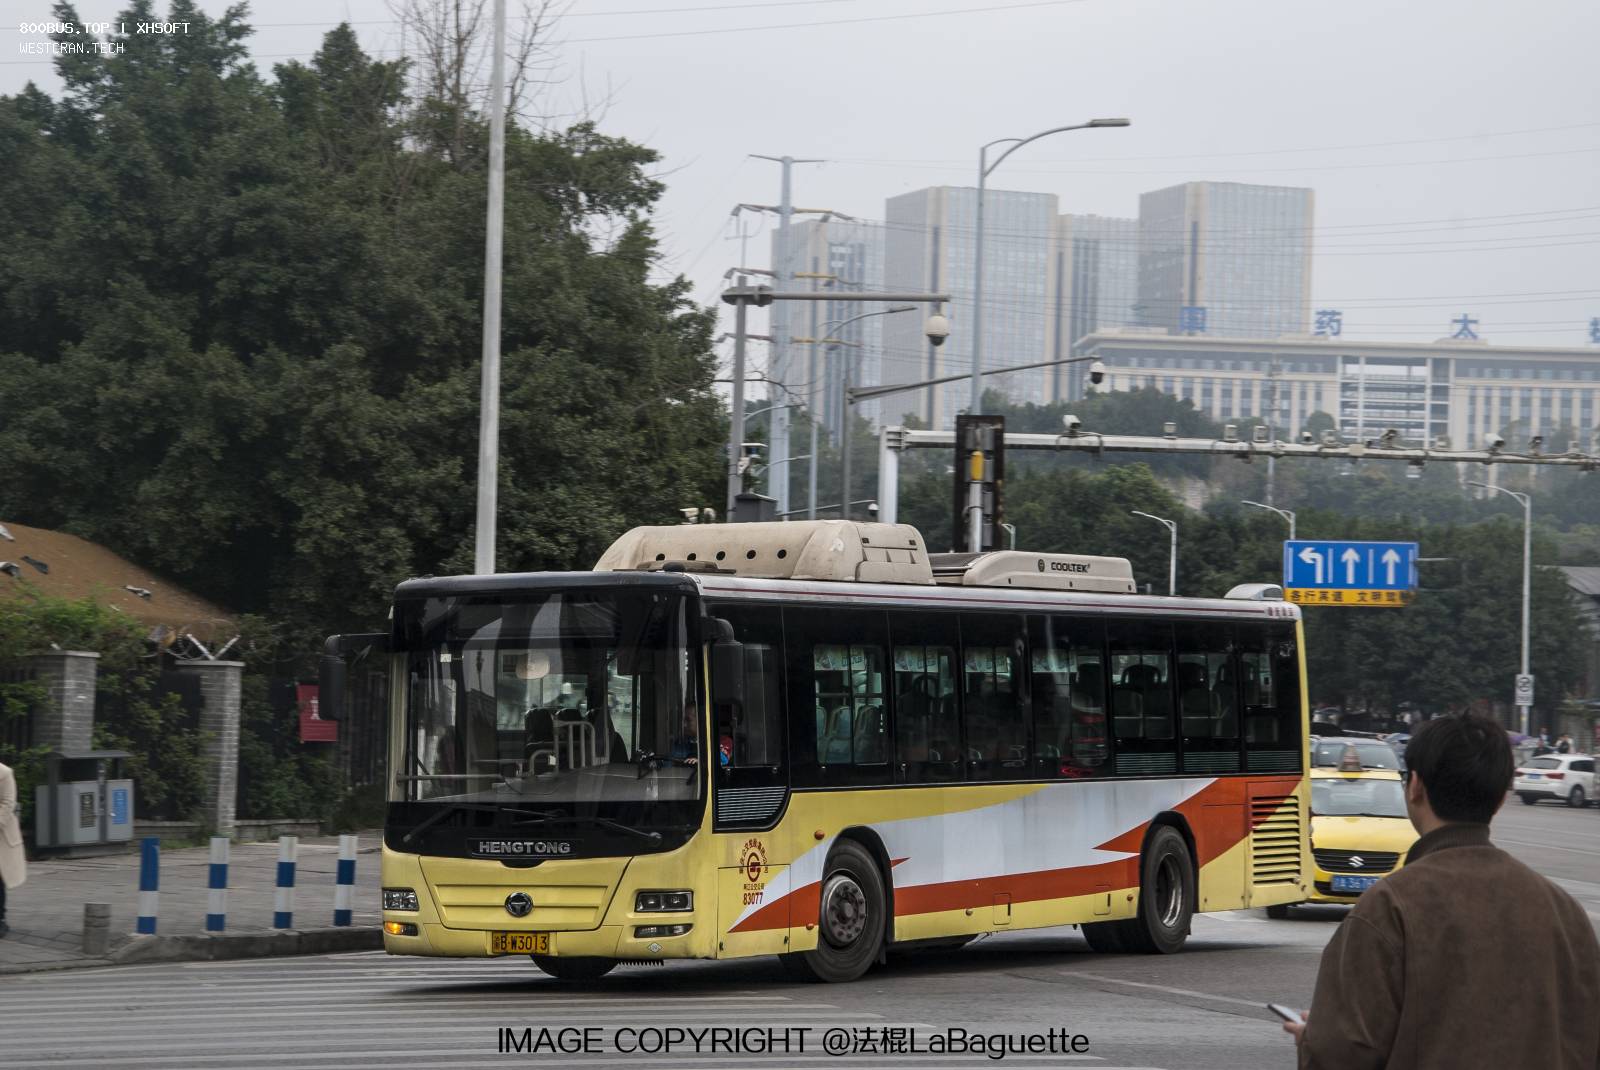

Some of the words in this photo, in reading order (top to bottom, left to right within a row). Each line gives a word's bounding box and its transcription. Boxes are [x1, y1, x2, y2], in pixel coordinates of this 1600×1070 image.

[1050, 562, 1088, 573] COOLTEK
[479, 841, 571, 854] HENGTONG
[743, 892, 763, 905] 83077
